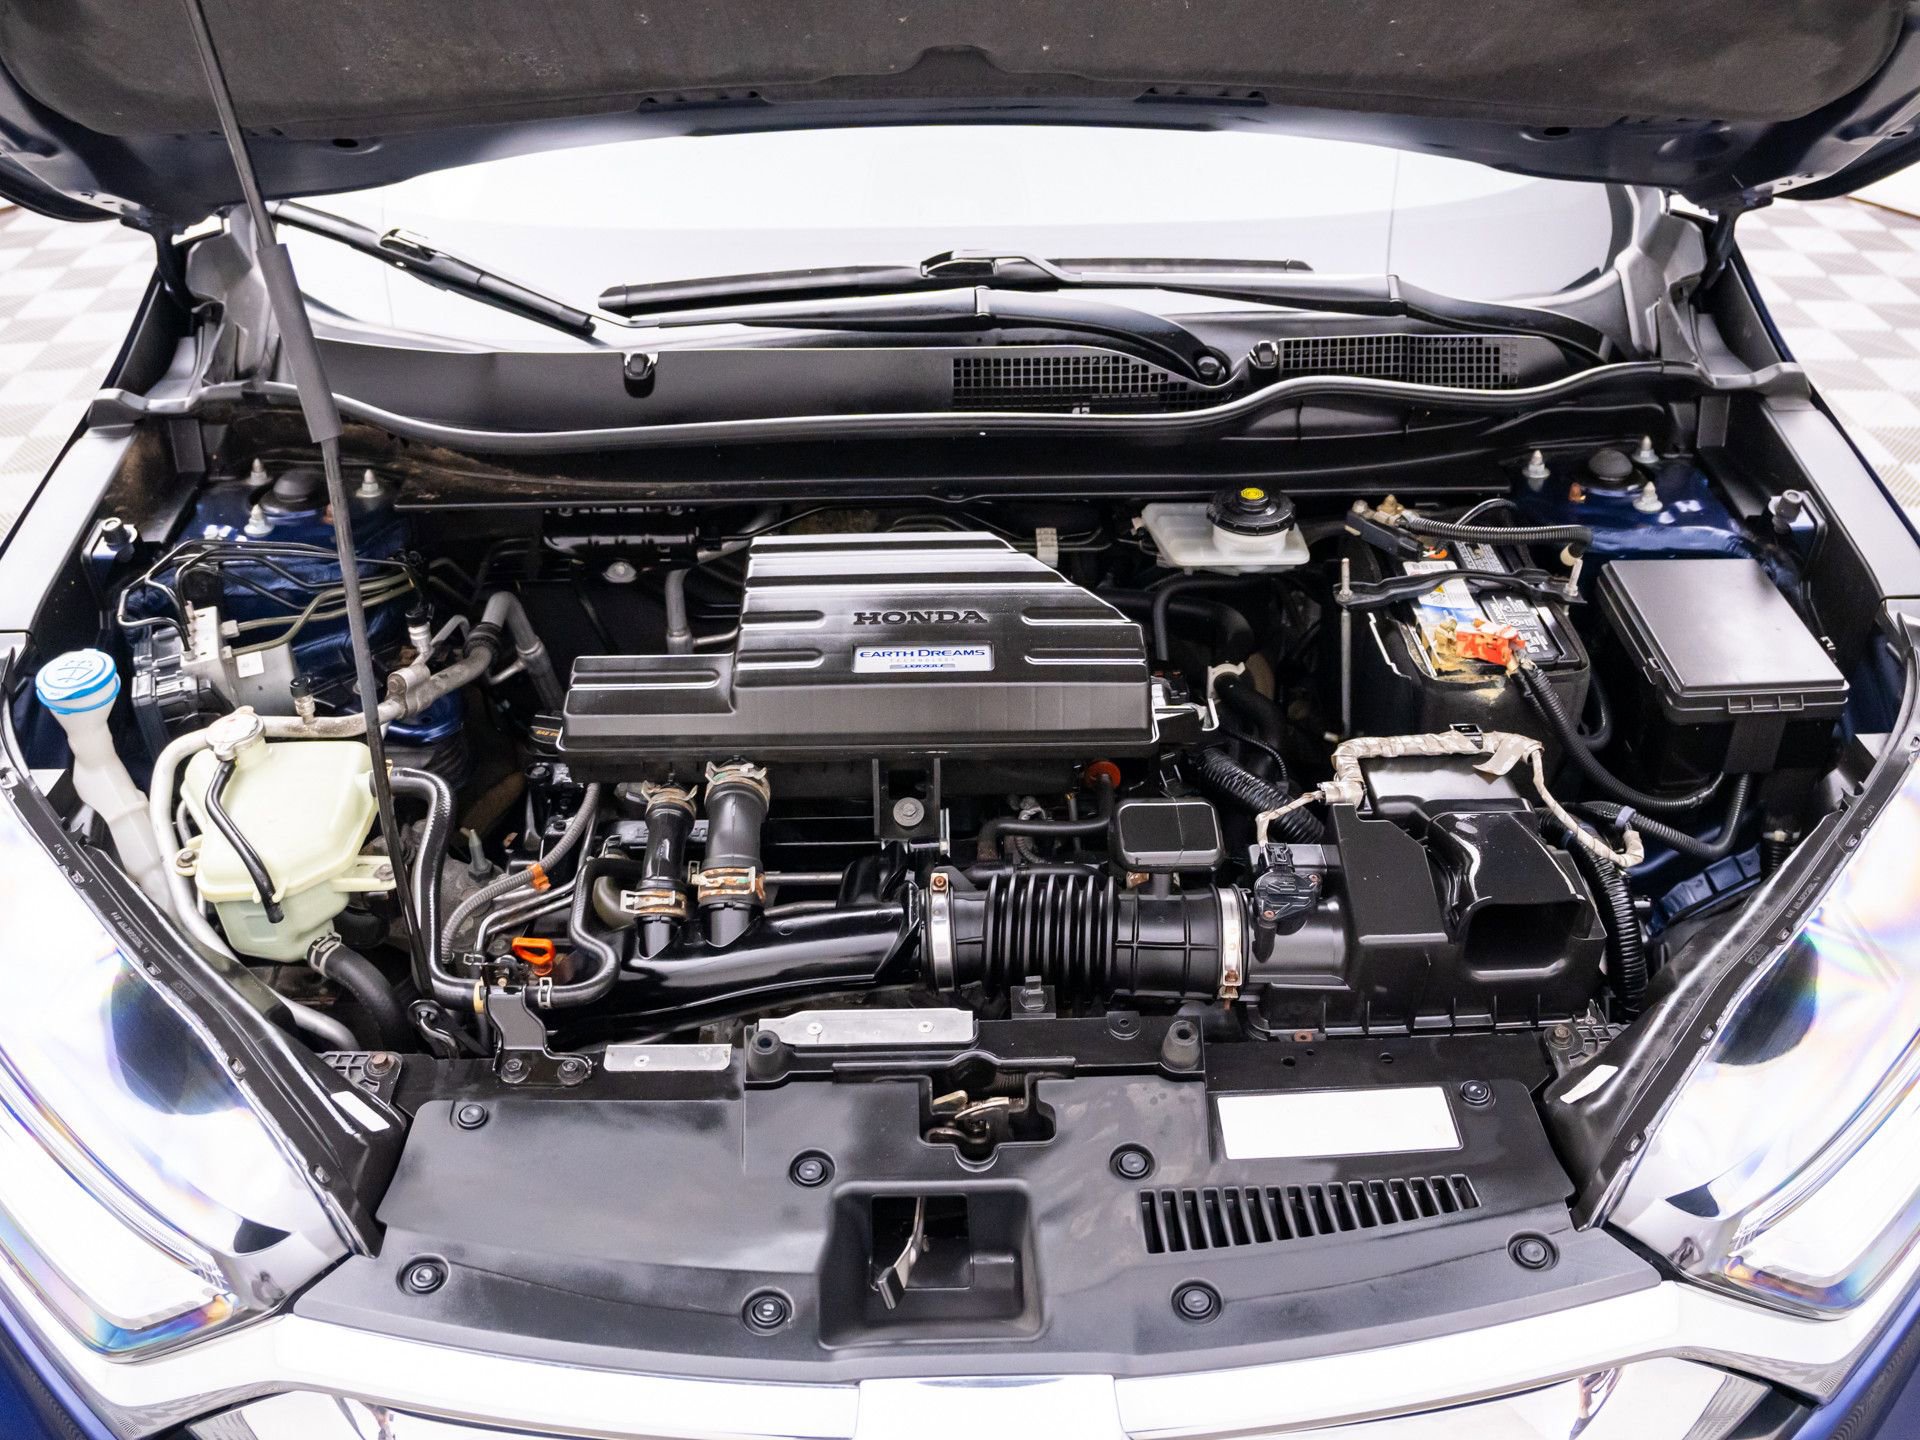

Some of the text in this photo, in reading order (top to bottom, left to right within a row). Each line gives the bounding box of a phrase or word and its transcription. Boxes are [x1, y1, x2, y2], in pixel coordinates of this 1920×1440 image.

[853, 610, 989, 626] HONDA
[859, 649, 986, 658] EARTH DREAMS
